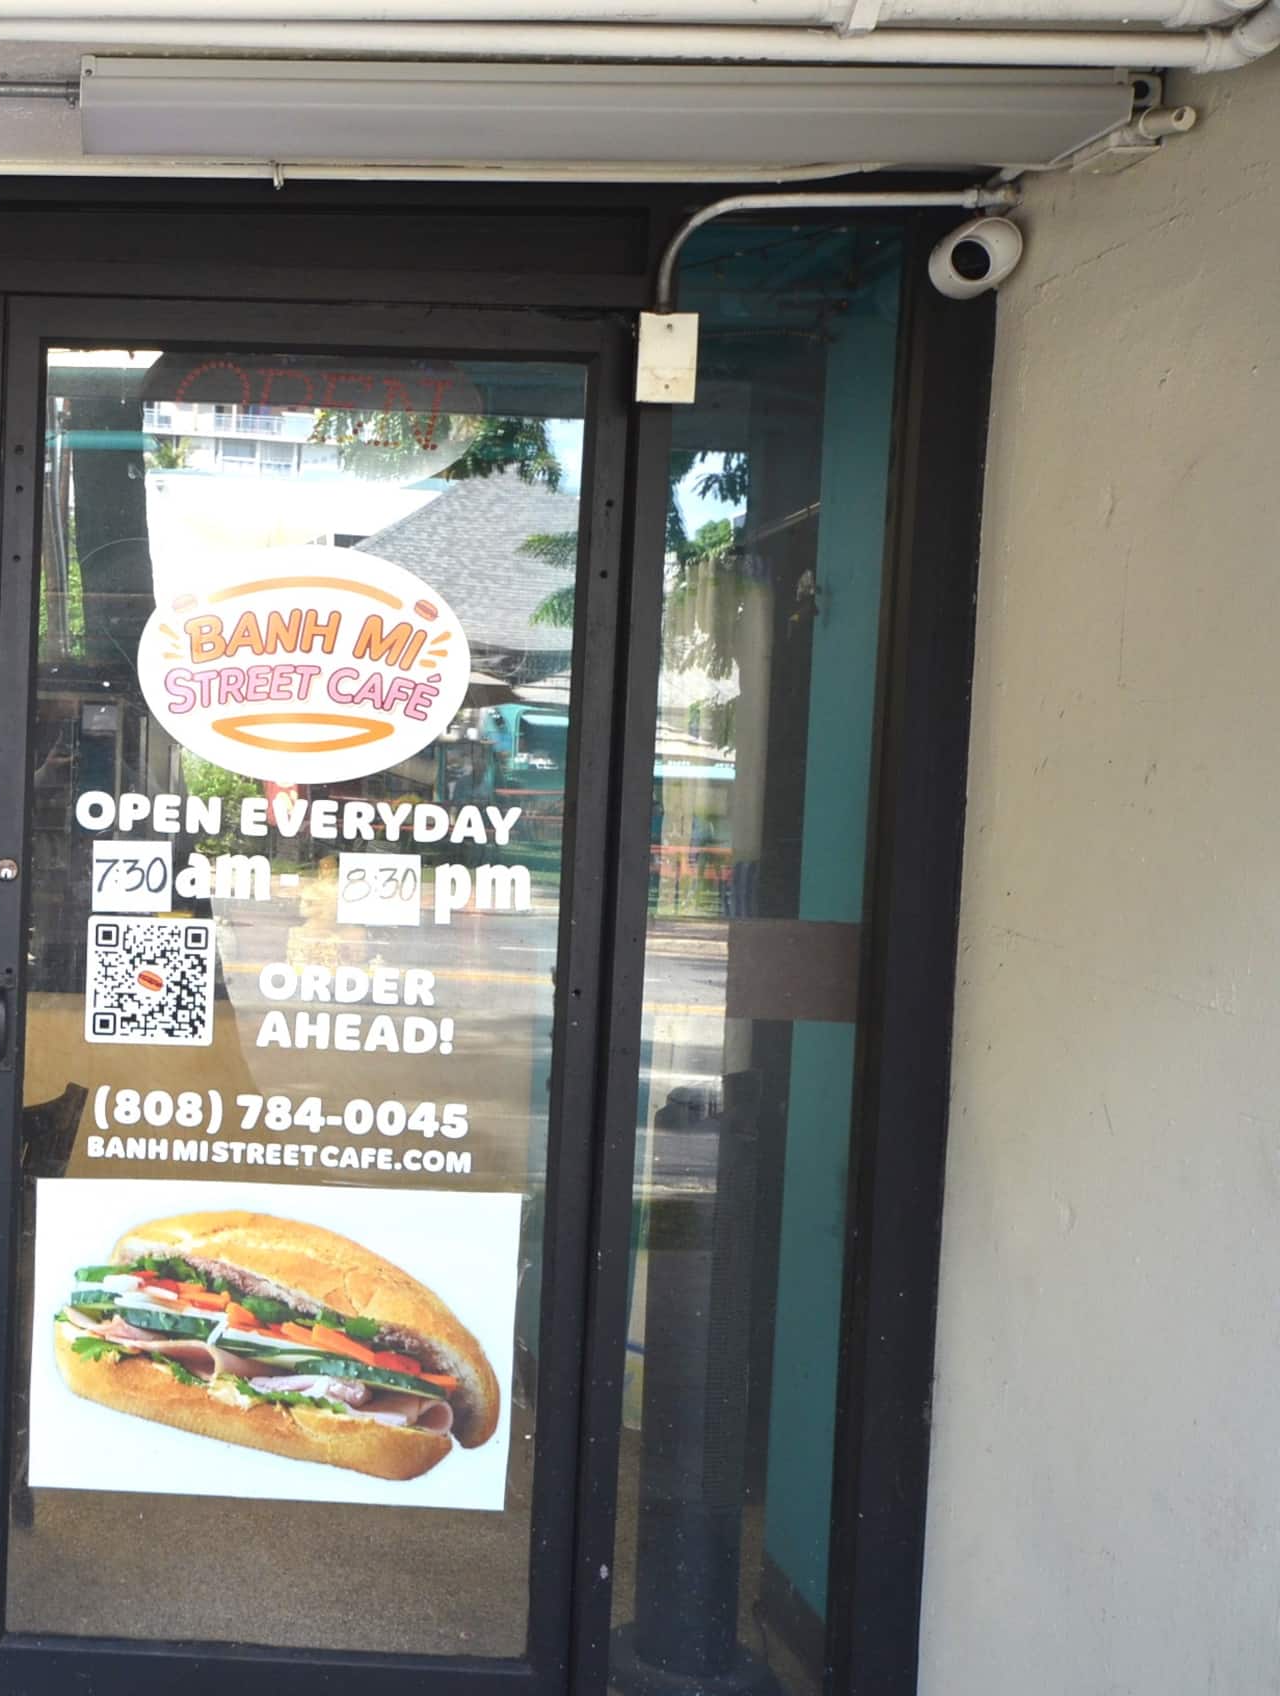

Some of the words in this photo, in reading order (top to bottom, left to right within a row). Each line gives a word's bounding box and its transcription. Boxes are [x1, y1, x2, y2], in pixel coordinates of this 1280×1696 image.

[184, 608, 342, 664] BANH
[352, 614, 428, 670] MI
[164, 664, 321, 715] STREET
[327, 667, 442, 721] CAFÉ
[76, 790, 222, 835] OPEN
[240, 797, 522, 846] EVERYDAY
[434, 863, 532, 925] pm
[258, 963, 436, 1006] ORDER
[255, 1011, 455, 1054] AHEAD!
[94, 1085, 223, 1135] (808)
[236, 1094, 469, 1139] 784-0045
